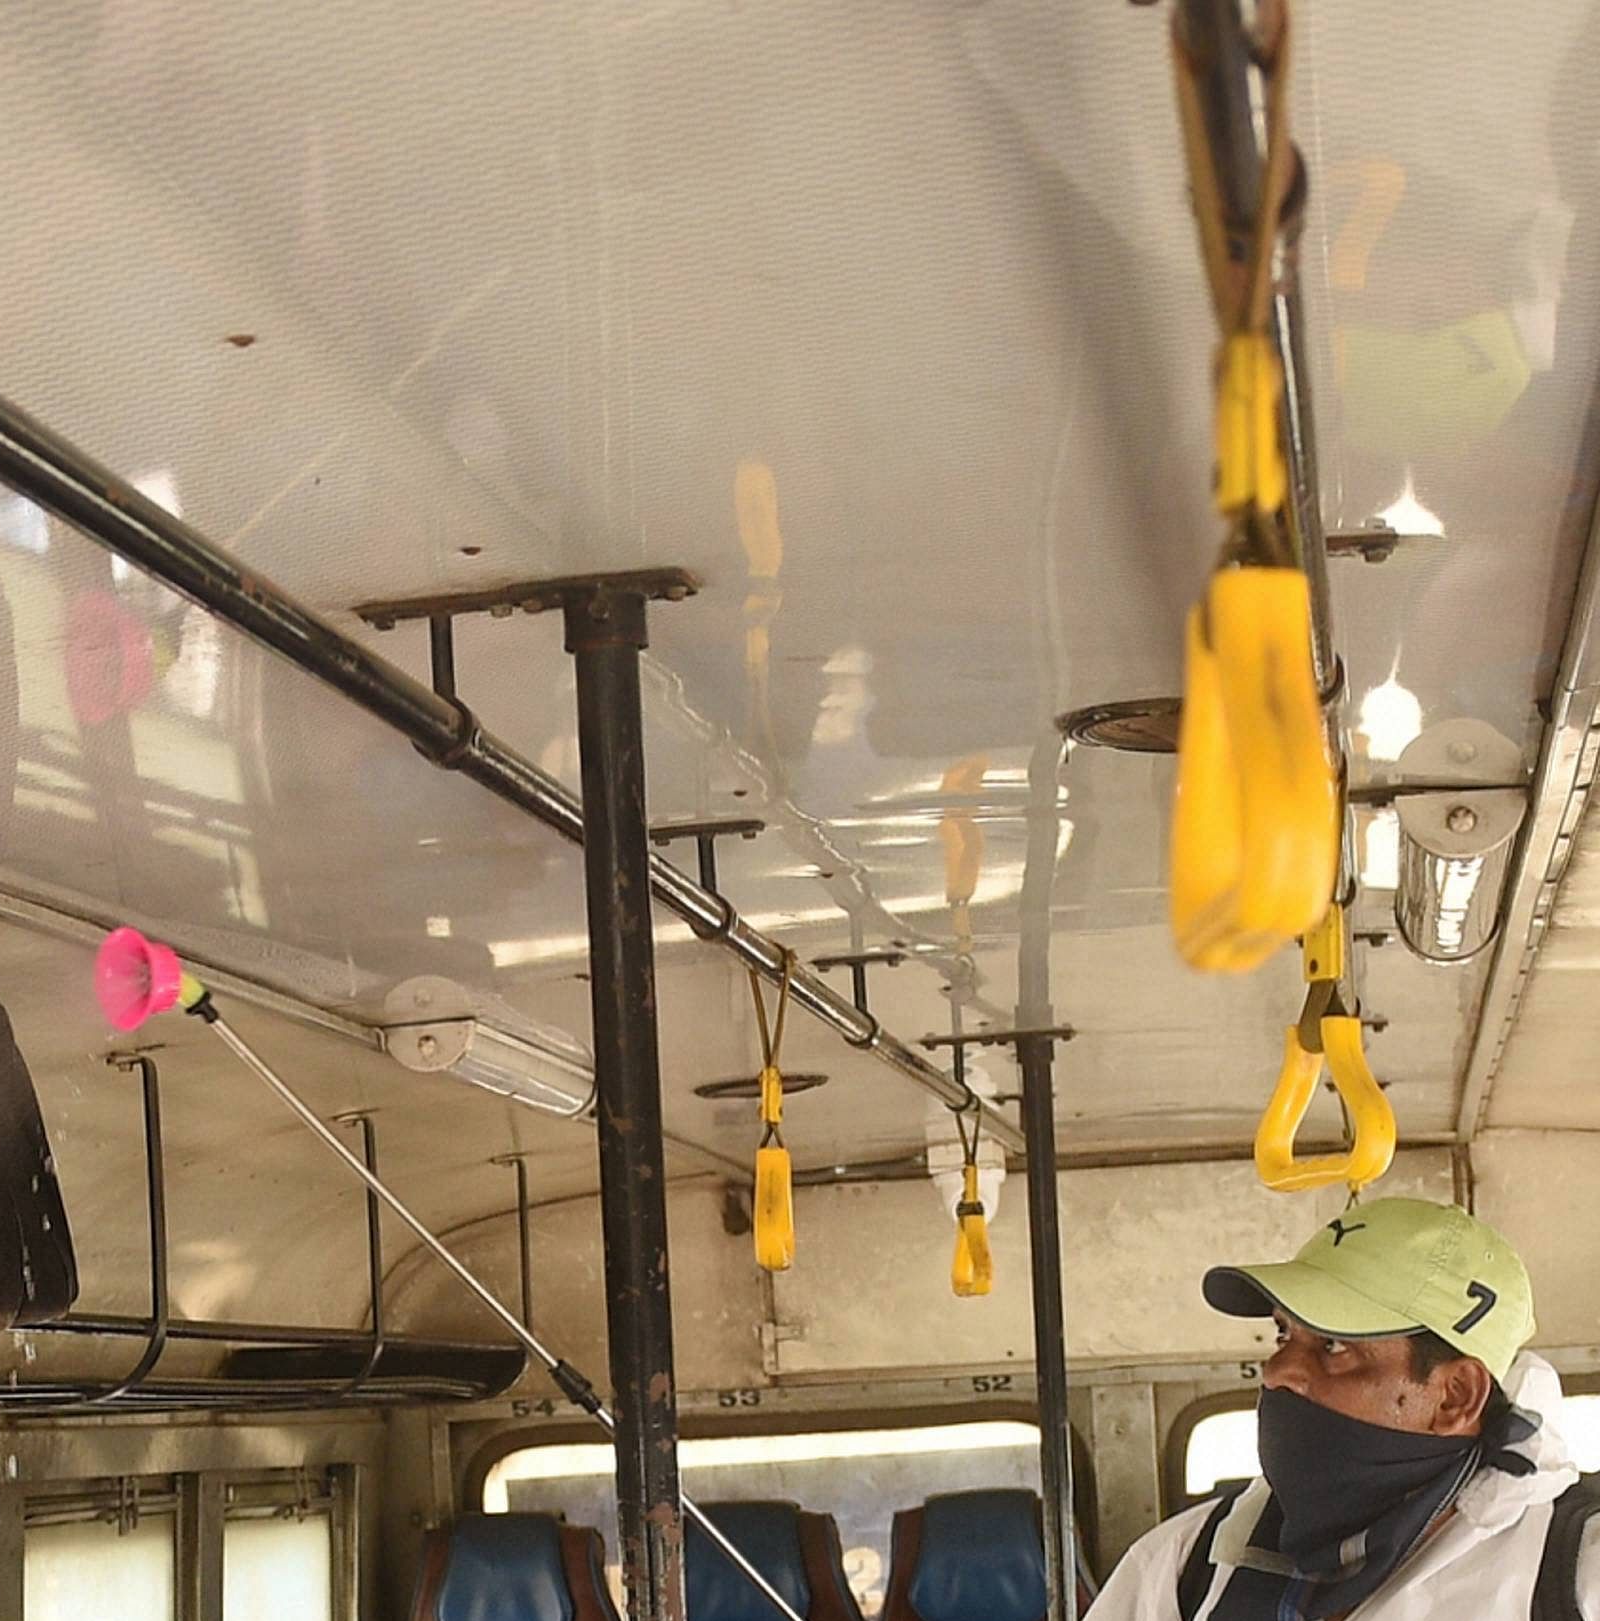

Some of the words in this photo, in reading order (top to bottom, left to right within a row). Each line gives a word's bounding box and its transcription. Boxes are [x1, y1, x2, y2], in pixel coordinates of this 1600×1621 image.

[1452, 1280, 1497, 1334] 7
[1240, 1361, 1262, 1379] 5
[973, 1375, 1012, 1392] 52
[717, 1390, 760, 1407] 53
[512, 1398, 556, 1418] 54
